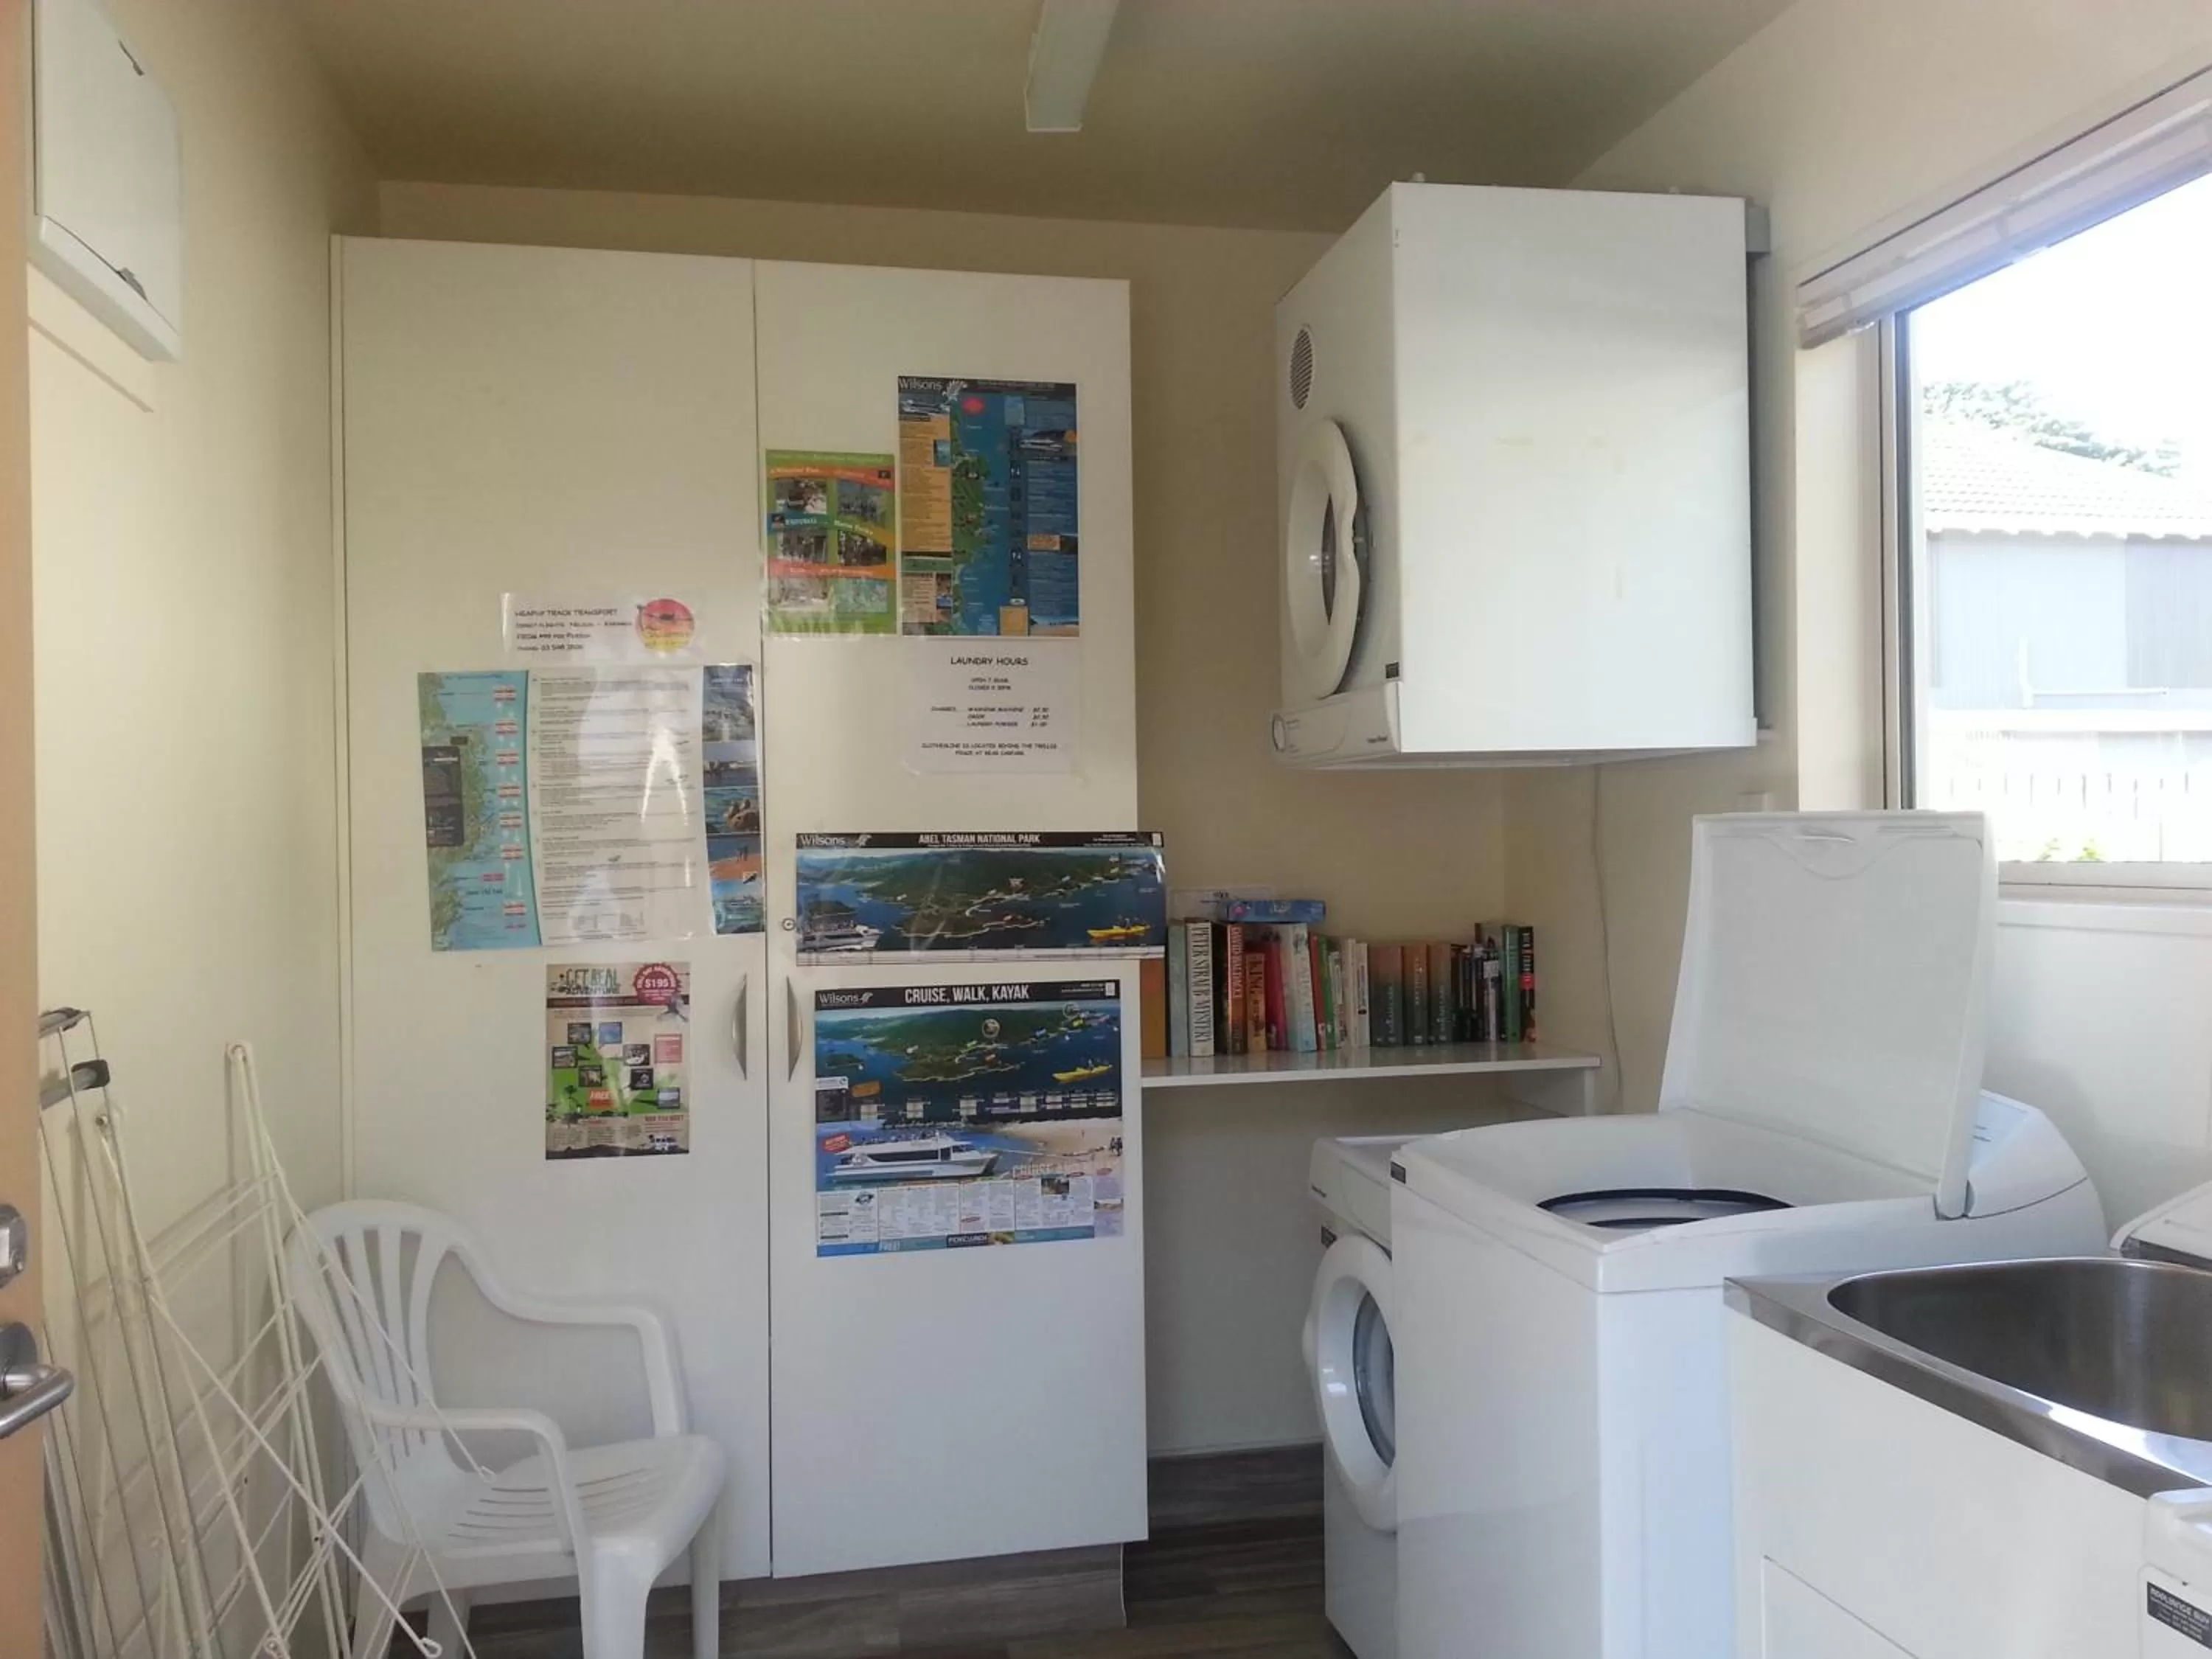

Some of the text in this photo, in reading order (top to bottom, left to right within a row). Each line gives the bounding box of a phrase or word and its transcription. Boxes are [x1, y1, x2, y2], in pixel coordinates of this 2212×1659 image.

[898, 378, 943, 391] Wilsons
[547, 608, 571, 616] TRACK
[573, 608, 618, 616] TRANSPORT
[950, 656, 1029, 666] LAUNDRY HOURS
[801, 833, 1040, 846] Wilsons ABEL TASMAN NATIONAL PARK
[1191, 927, 1210, 959] PETER
[644, 978, 669, 989] $195
[1191, 959, 1211, 996] STRAUB
[819, 992, 859, 1004] Wilsons
[953, 985, 990, 1003] WALK,
[992, 984, 1029, 1000] KAYAK
[1193, 1001, 1212, 1044] MYSTERY
